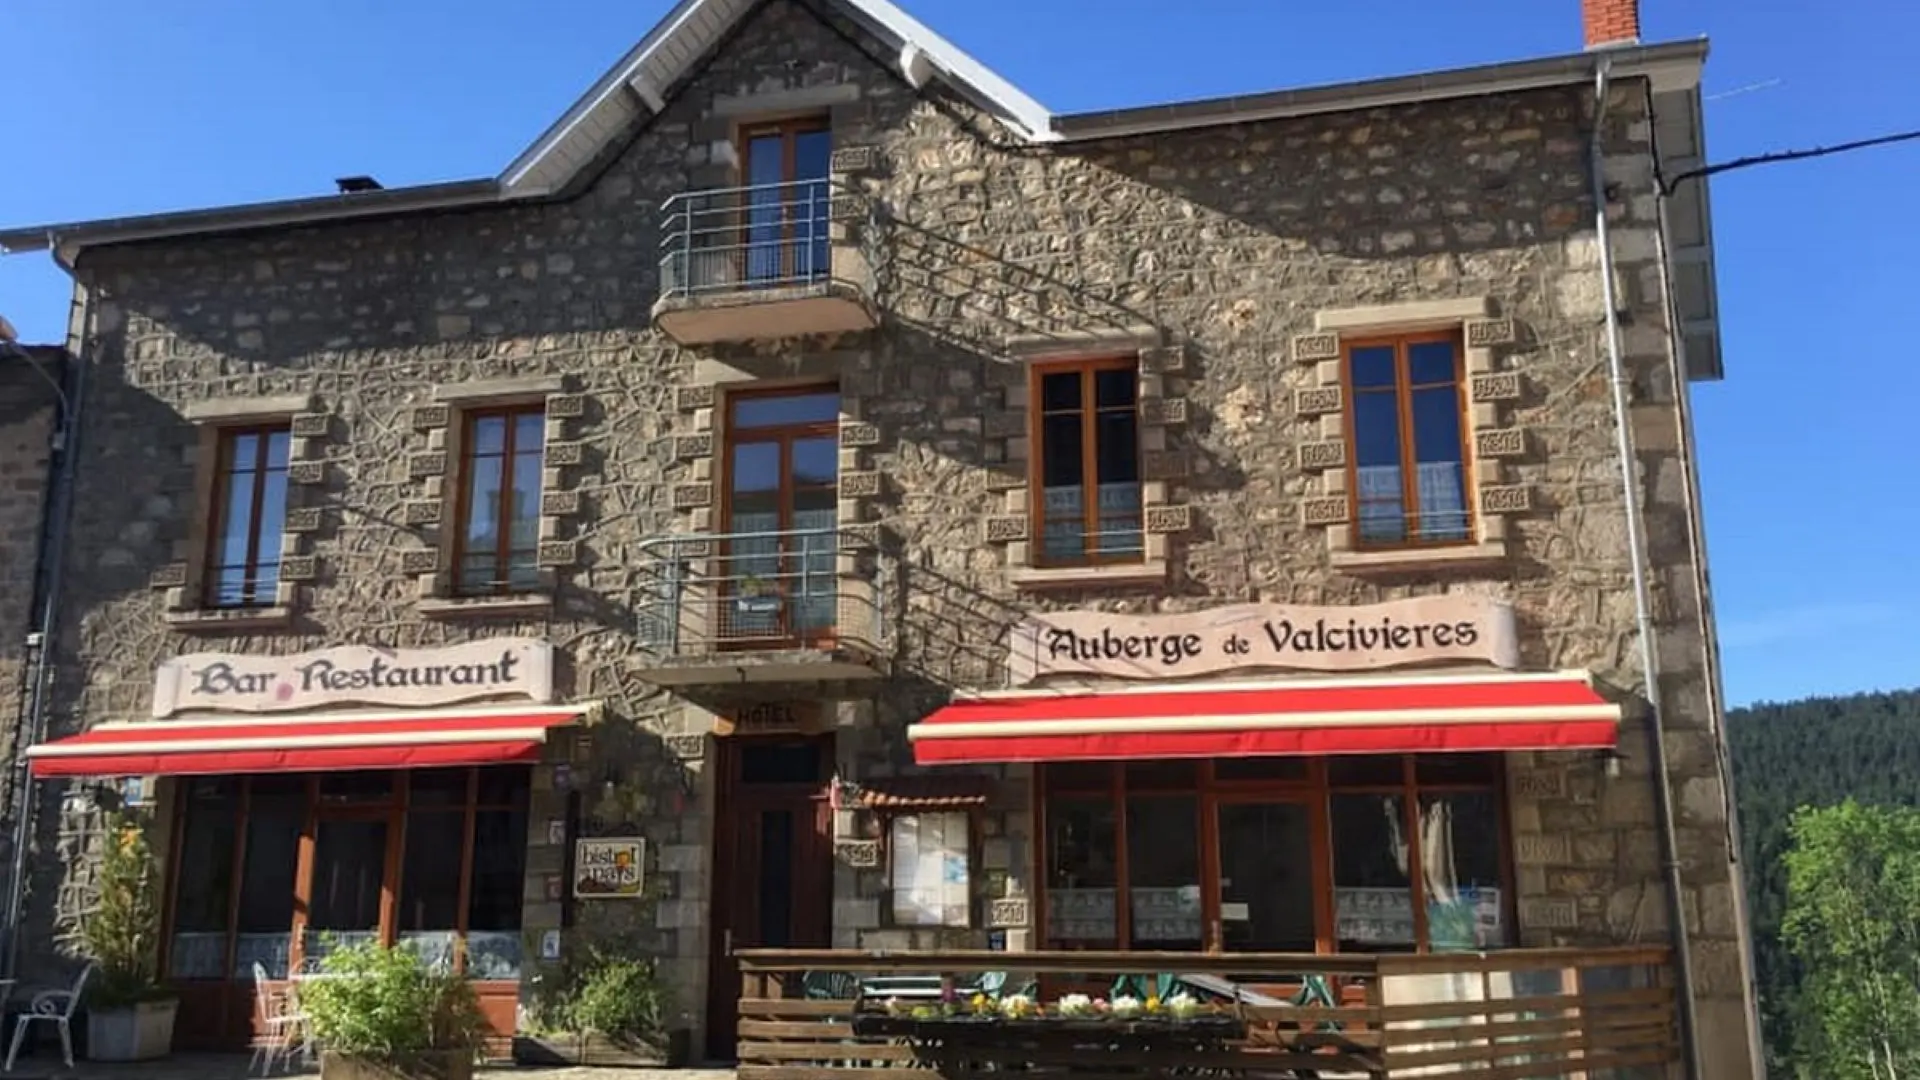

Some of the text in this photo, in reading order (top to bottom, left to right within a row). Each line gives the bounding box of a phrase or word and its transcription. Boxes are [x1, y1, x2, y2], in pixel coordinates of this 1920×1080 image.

[1046, 616, 1479, 666] Auberge de Valcivieres
[192, 649, 520, 695] Bar Restaurant
